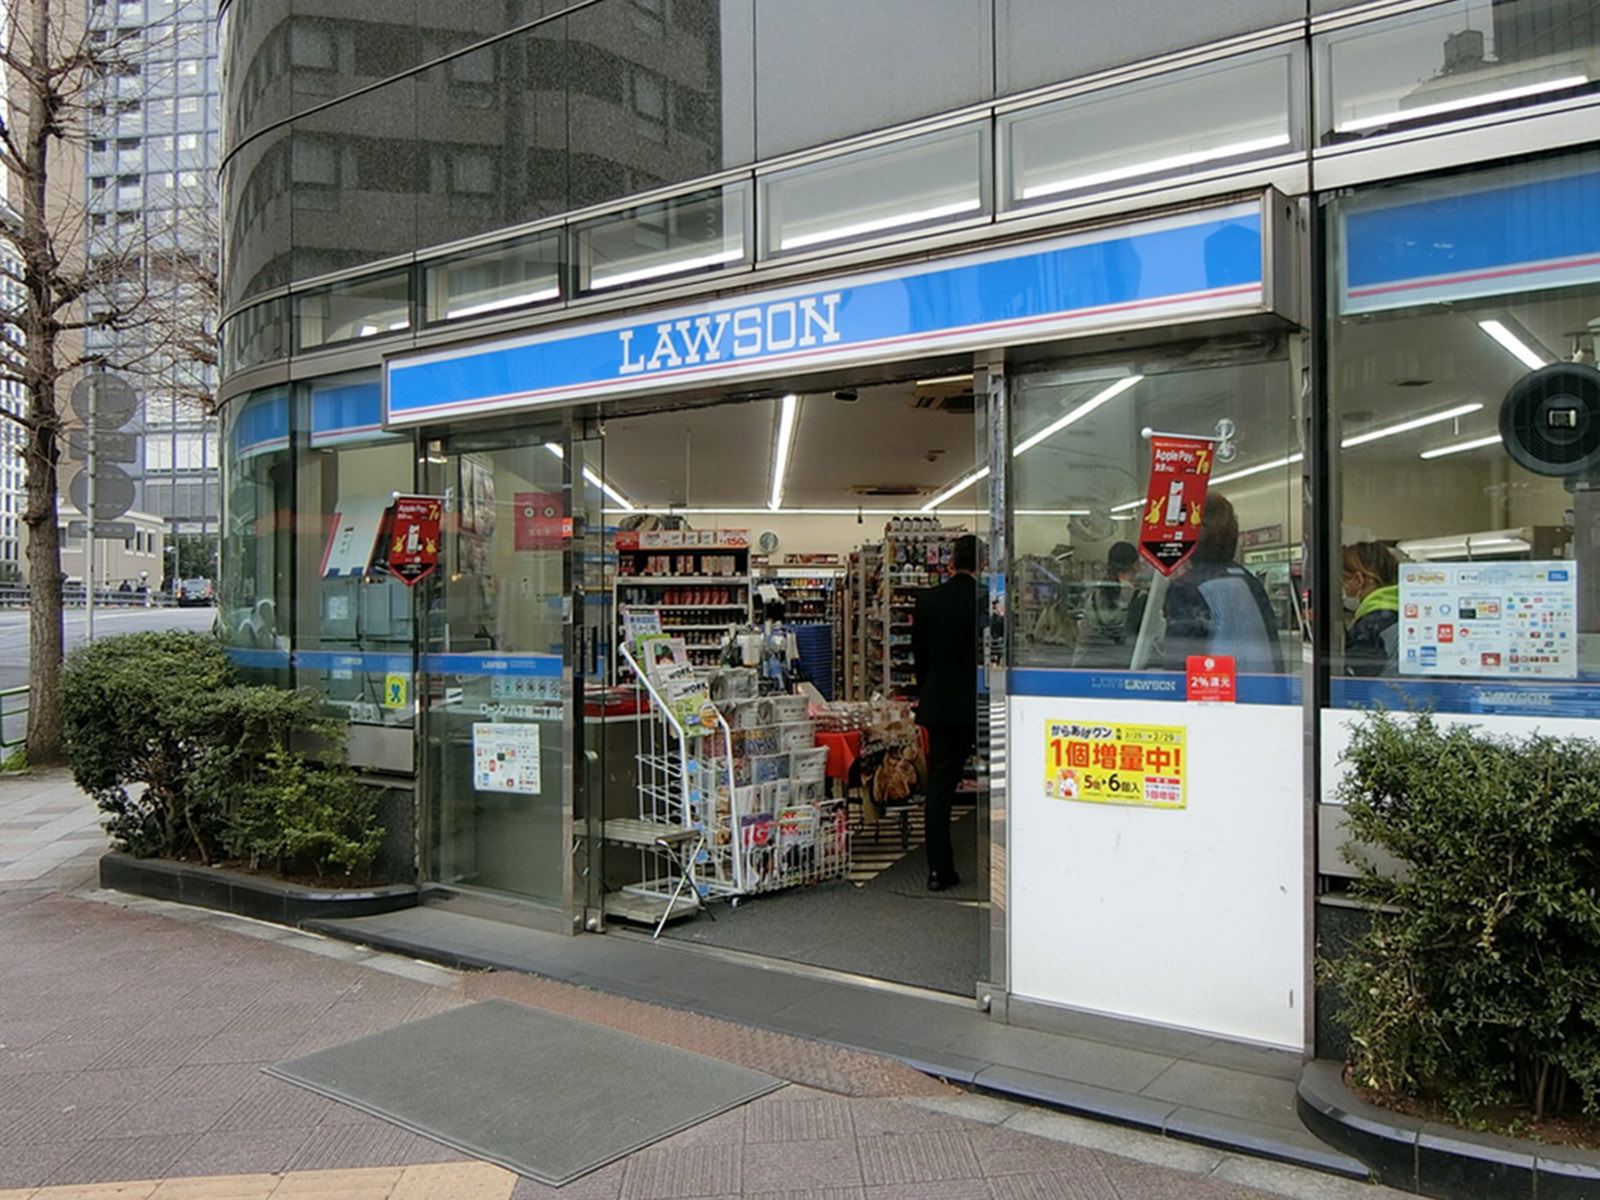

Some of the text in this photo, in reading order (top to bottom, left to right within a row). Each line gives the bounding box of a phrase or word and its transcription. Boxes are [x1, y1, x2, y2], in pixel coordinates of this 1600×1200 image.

[619, 293, 841, 375] LAWSON
[1155, 448, 1193, 464] Apple Pay
[1051, 724, 1113, 740] からあげクン
[1050, 738, 1182, 775] 1個増量中!
